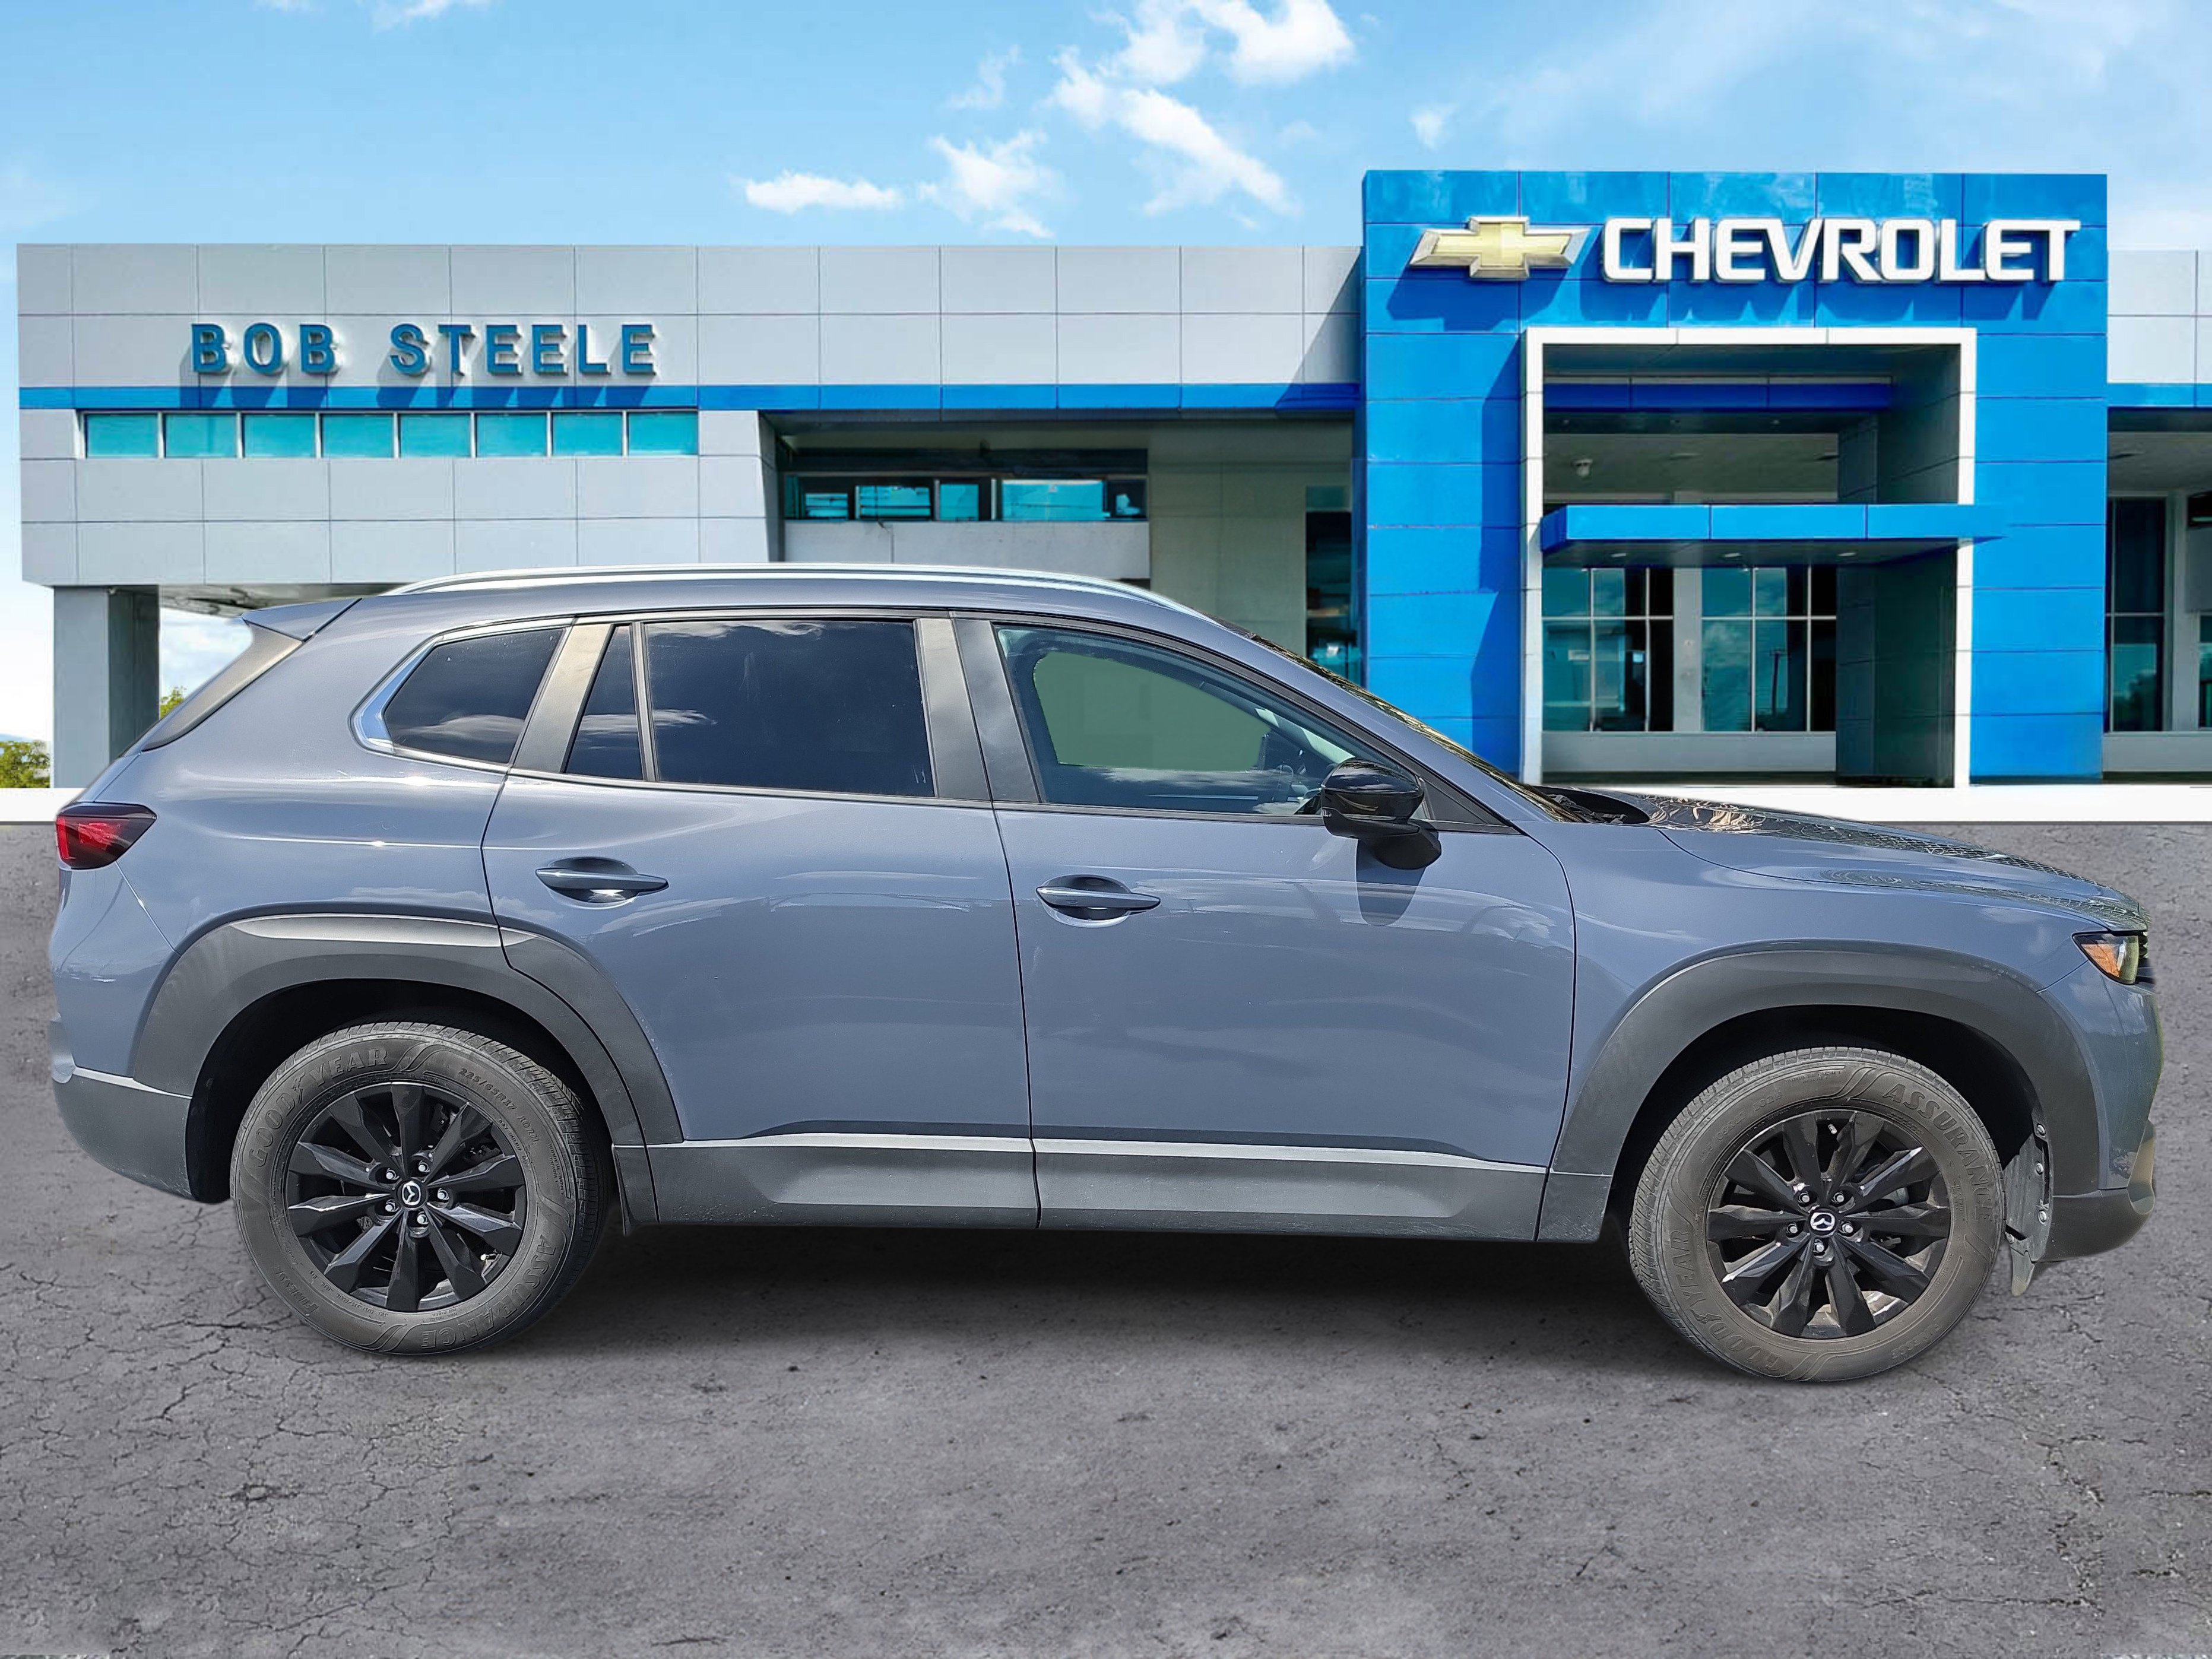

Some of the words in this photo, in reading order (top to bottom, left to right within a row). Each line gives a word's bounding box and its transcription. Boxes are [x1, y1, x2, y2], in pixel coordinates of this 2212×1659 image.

[1601, 217, 2081, 284] CHEVROLET
[191, 322, 341, 376] BOB
[390, 322, 657, 376] STEELE
[458, 1068, 518, 1111] 225/65R17
[1883, 1083, 1993, 1222] ASSURANCE
[420, 1235, 557, 1350] ASSURANCE
